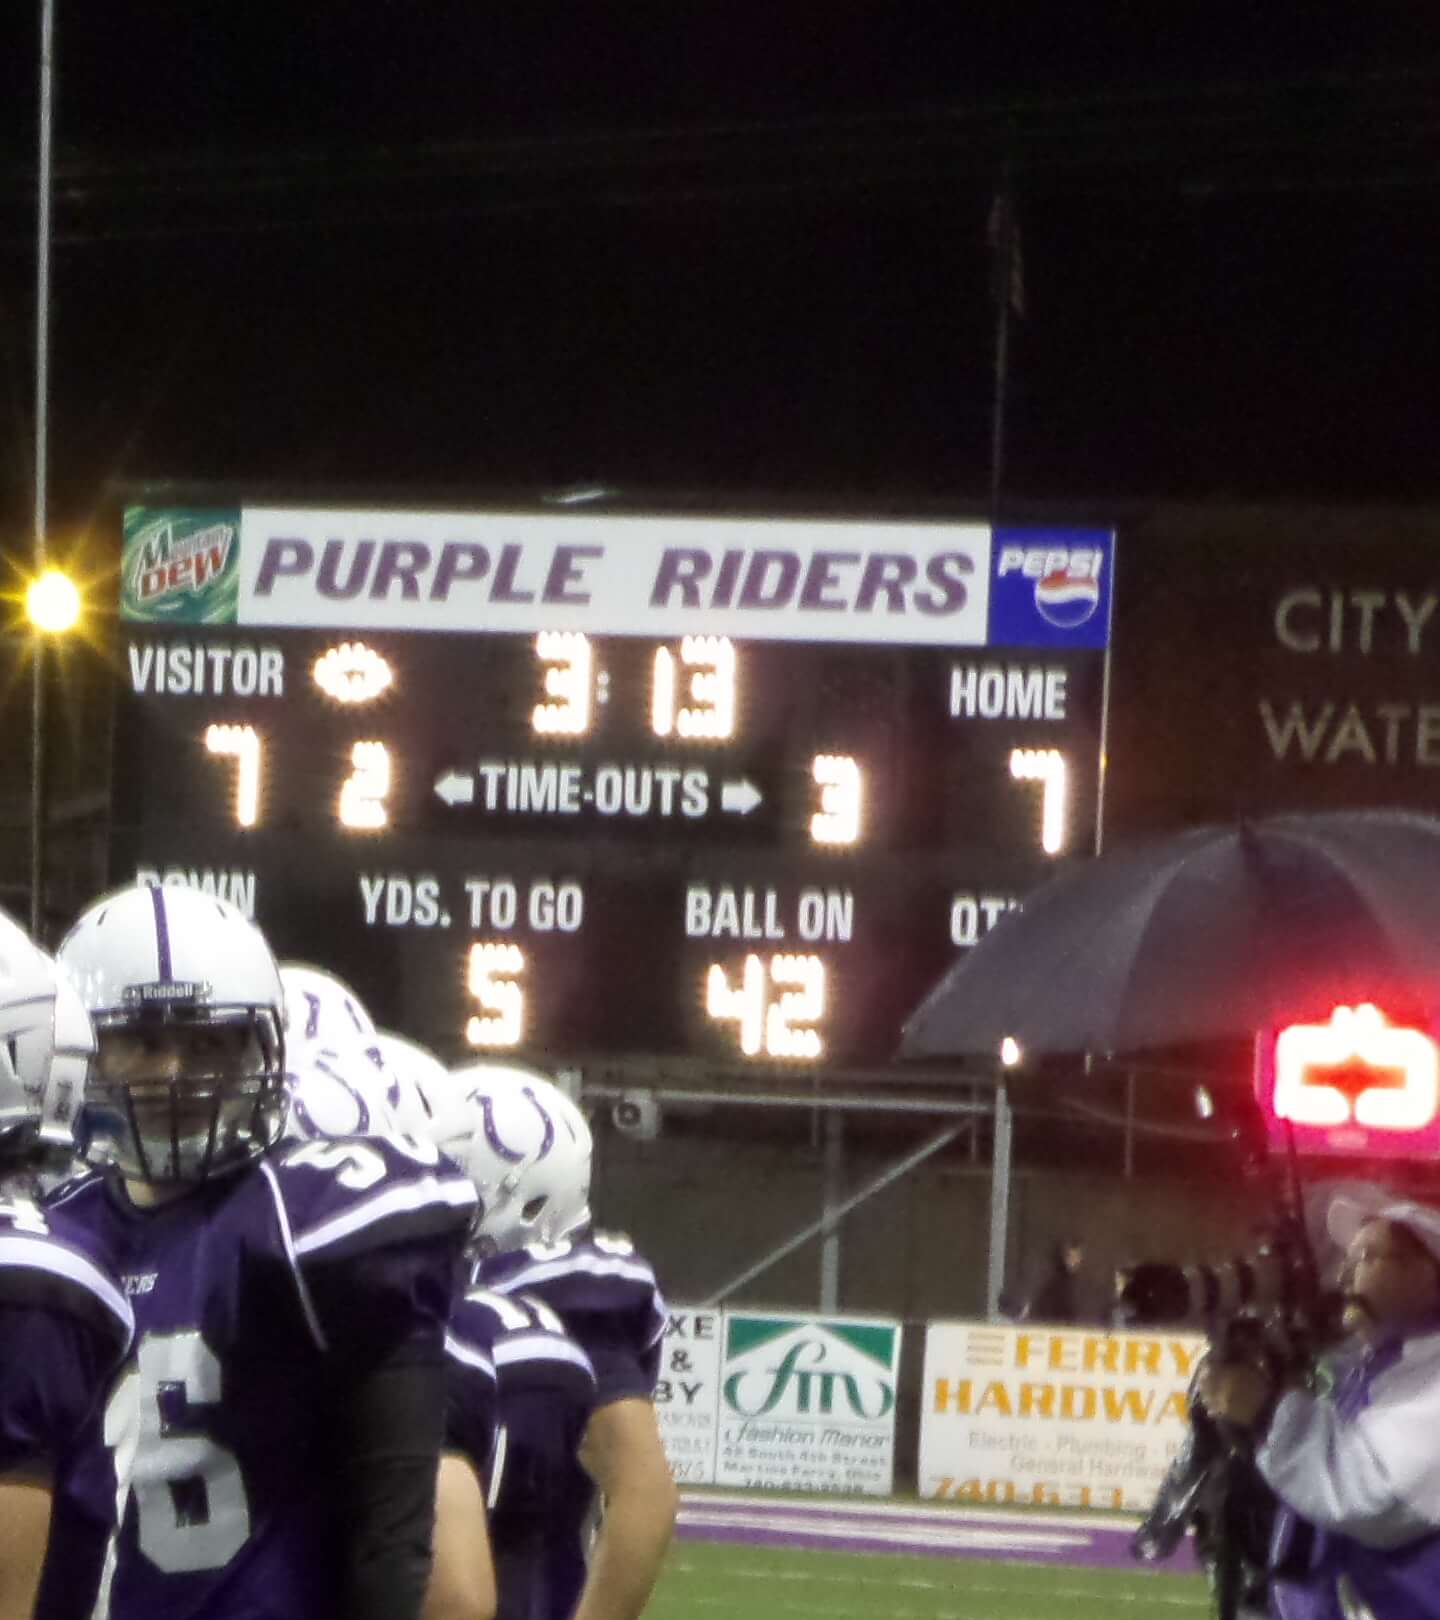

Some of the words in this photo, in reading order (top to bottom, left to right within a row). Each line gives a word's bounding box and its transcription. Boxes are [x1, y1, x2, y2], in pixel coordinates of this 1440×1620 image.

[253, 536, 605, 605] PURPLE
[649, 547, 975, 617] RIDERS
[999, 546, 1104, 579] PEPSI
[1275, 589, 1437, 654] CITY
[128, 644, 285, 697] VISITOR
[950, 667, 1068, 719] HOME
[206, 723, 260, 826] 7
[340, 741, 390, 827] 2
[479, 763, 709, 818] TIME-OUTS
[811, 755, 860, 843] 3
[1010, 749, 1066, 854] 7
[360, 877, 451, 928] YDS.
[466, 881, 516, 930] TO
[529, 883, 584, 932] GO
[685, 886, 785, 937] BALL
[799, 889, 854, 942] ON
[951, 895, 1024, 946] QT
[466, 943, 524, 1045] 5
[706, 954, 825, 1058] 42
[1015, 1333, 1199, 1377] FERRY
[134, 1330, 251, 1574] 6
